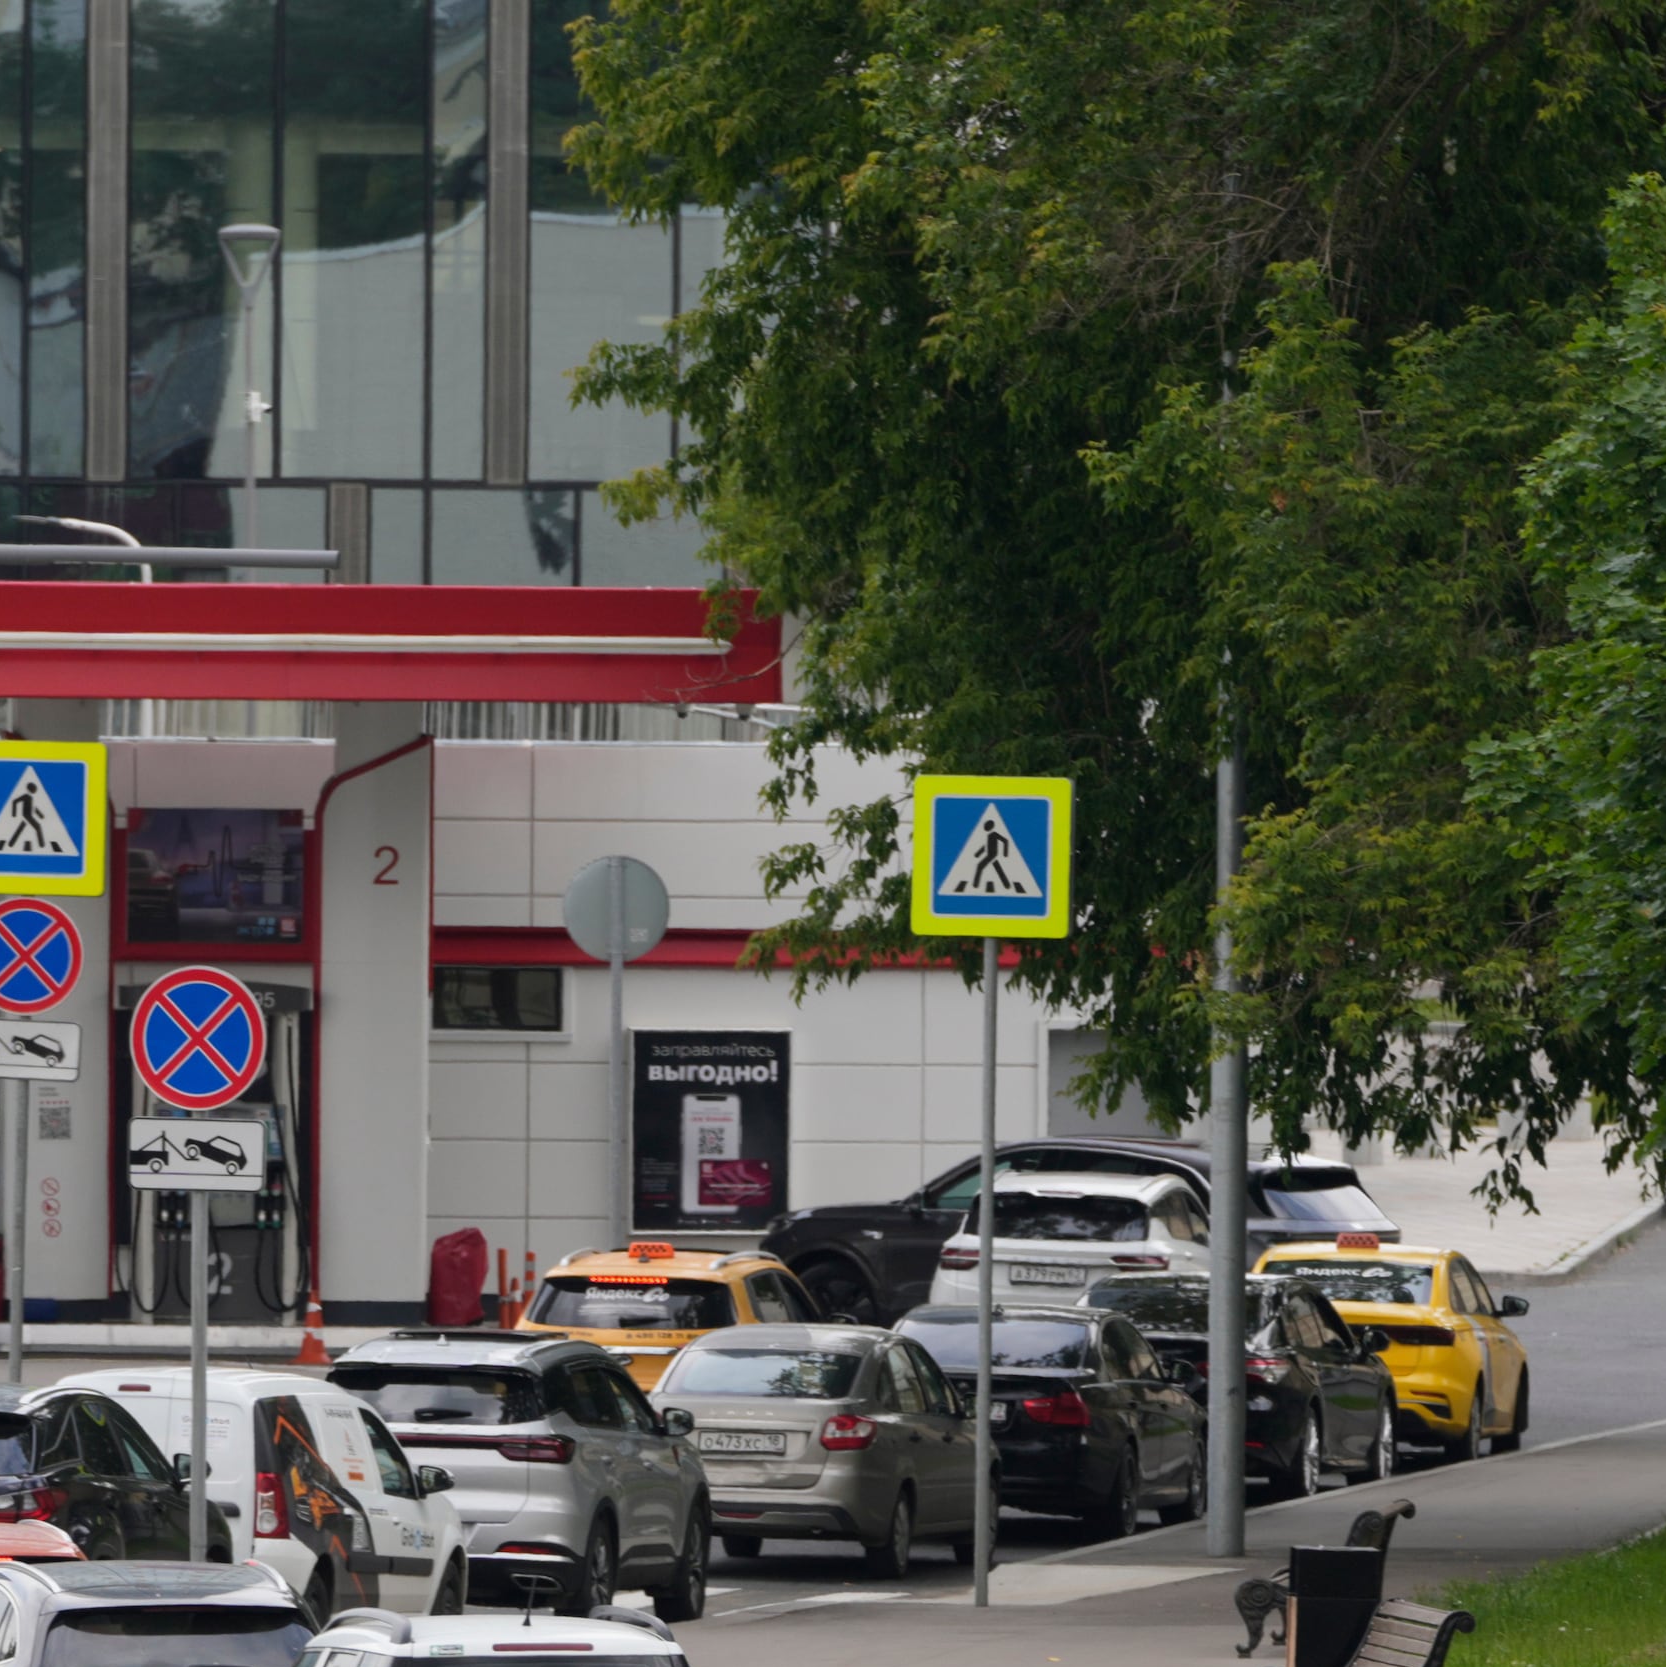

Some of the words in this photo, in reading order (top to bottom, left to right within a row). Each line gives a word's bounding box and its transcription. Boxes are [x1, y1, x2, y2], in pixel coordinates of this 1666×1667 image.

[372, 845, 400, 885] 2
[651, 1043, 776, 1058] заправляйтесь
[648, 1060, 779, 1086] выгодно!
[1295, 1266, 1362, 1277] Яндекс
[584, 1286, 643, 1301] Яндекс
